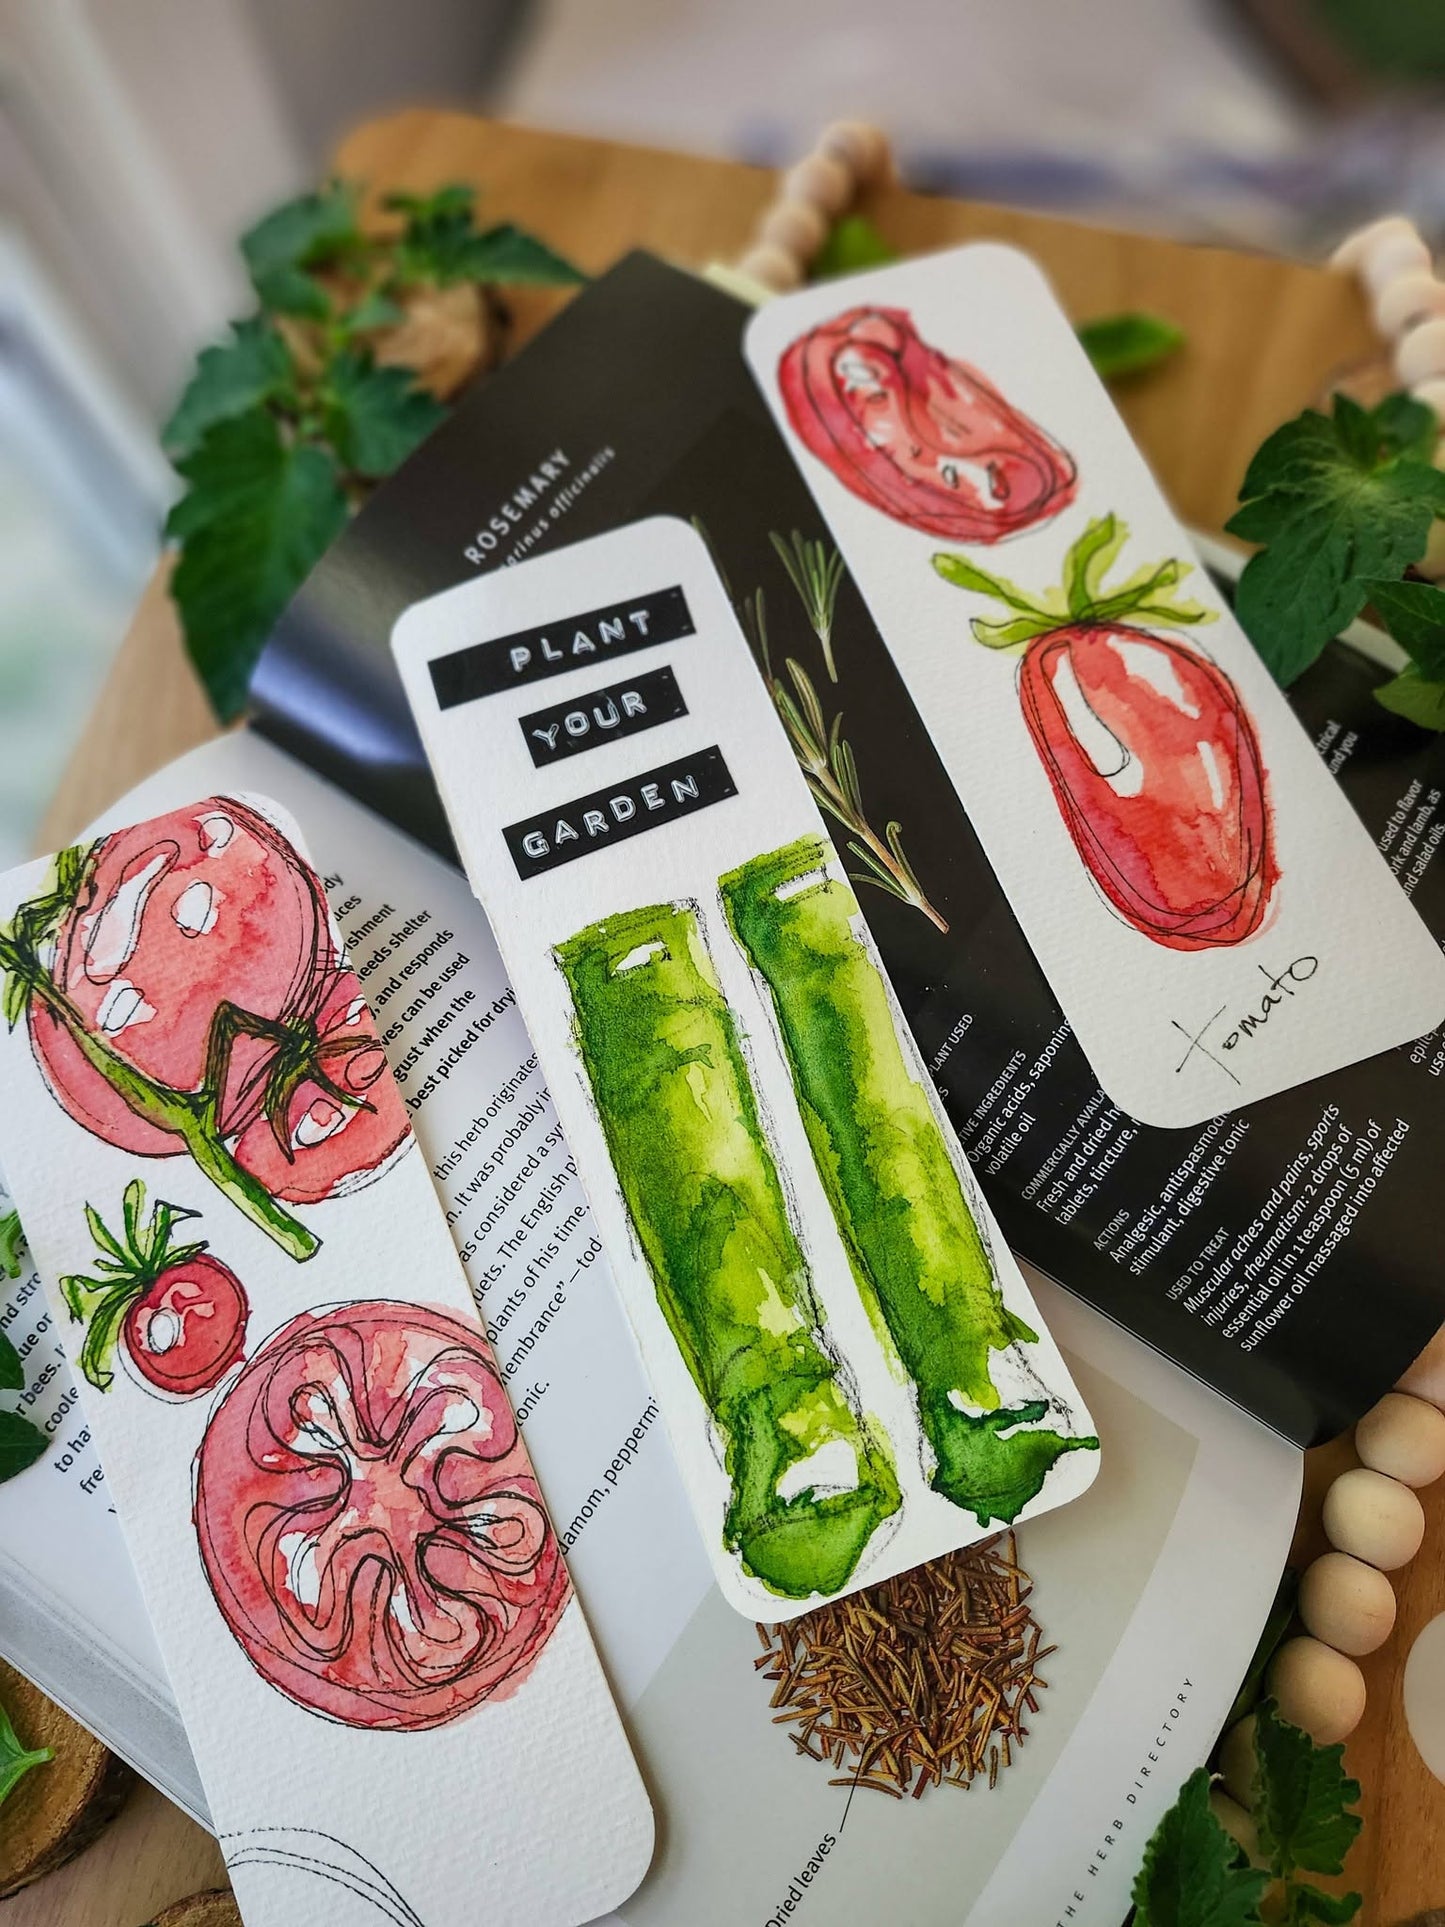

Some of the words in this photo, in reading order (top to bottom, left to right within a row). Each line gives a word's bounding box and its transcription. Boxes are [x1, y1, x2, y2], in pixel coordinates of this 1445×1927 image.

[464, 450, 569, 565] ROSEMARY
[505, 519, 549, 569] arinus
[510, 609, 650, 673] PLANT
[532, 690, 648, 751] YOUR
[1338, 731, 1358, 756] you
[522, 774, 701, 859] GARDEN
[1390, 811, 1407, 824] to
[1396, 779, 1423, 812] flavor
[1407, 806, 1436, 834] lamb,
[1427, 789, 1441, 804] as
[1376, 821, 1400, 852] used
[1390, 854, 1407, 876] ork
[1399, 831, 1418, 856] and
[1412, 841, 1436, 876] salad
[389, 910, 432, 949] shelter
[376, 976, 403, 1004] and
[398, 929, 454, 981] responds
[381, 1021, 404, 1046] ves
[401, 998, 427, 1022] can
[419, 981, 443, 999] be
[438, 952, 471, 983] used
[948, 1014, 973, 1044] USED
[392, 1046, 425, 1084] gust
[419, 1011, 457, 1047] when
[449, 990, 476, 1012] the
[404, 1075, 441, 1110] best
[436, 1029, 480, 1080] picked
[472, 1011, 496, 1033] for
[491, 987, 517, 1014] dryi
[958, 1117, 979, 1145] TIVE
[973, 1050, 1026, 1120] INGREDIENTS
[967, 1116, 1007, 1162] Organic
[1001, 1082, 1036, 1118] acids,
[1367, 1118, 1382, 1139] of
[432, 1151, 462, 1181] this
[454, 1117, 489, 1152] herb
[454, 1192, 473, 1207] It
[466, 1162, 495, 1193] was
[490, 1099, 545, 1166] probably
[985, 1132, 1023, 1175] volatile
[1018, 1112, 1036, 1133] oil
[1021, 1124, 1081, 1200] COMMERCIALLY
[1076, 1089, 1105, 1128] AVAILA
[1310, 1143, 1343, 1184] drops
[1338, 1123, 1353, 1143] of
[1352, 1138, 1374, 1164] ml)
[1036, 1180, 1069, 1213] Fresh
[1064, 1152, 1088, 1182] and
[1081, 1117, 1113, 1156] dried
[1054, 1183, 1099, 1225] tablets,
[1089, 1129, 1138, 1181] tincture,
[1109, 1204, 1167, 1264] Analgesic,
[1159, 1115, 1227, 1203] antispasmod
[1304, 1184, 1318, 1196] 2
[1339, 1163, 1360, 1180] (5
[457, 1241, 477, 1264] as
[474, 1154, 541, 1241] considered
[536, 1146, 550, 1157] a
[496, 1230, 528, 1259] The
[520, 1173, 570, 1230] English
[1129, 1218, 1185, 1275] stimulant,
[1177, 1155, 1226, 1216] digestive
[1218, 1119, 1250, 1155] tonic
[1183, 1256, 1234, 1314] Muscular
[1231, 1219, 1264, 1261] aches
[1260, 1188, 1284, 1221] and
[1279, 1152, 1314, 1197] pains,
[1307, 1103, 1339, 1151] sports
[1296, 1179, 1348, 1245] teaspoon
[1093, 1208, 1130, 1251] ACTIONS
[1240, 1292, 1295, 1352] sunflower
[1291, 1273, 1310, 1294] oil
[1304, 1203, 1359, 1277] massaged
[1349, 1177, 1376, 1206] into
[1371, 1118, 1410, 1178] affected
[1244, 1195, 1310, 1281] rheumatism:
[1293, 1244, 1305, 1254] 1
[483, 1289, 526, 1346] plants
[523, 1264, 540, 1288] of
[532, 1242, 559, 1269] his
[553, 1205, 590, 1242] time.
[1165, 1275, 1192, 1300] USED
[1187, 1260, 1204, 1276] TO
[1198, 1226, 1229, 1261] TREAT
[1268, 1265, 1287, 1287] oil
[1277, 1253, 1298, 1269] in
[1200, 1281, 1250, 1327] injuries,
[1222, 1283, 1273, 1338] essential
[19, 1363, 61, 1406] bees.
[54, 1454, 74, 1473] to
[1087, 1819, 1123, 1876] HERB
[1126, 1678, 1193, 1805] DIRECTORY
[765, 1885, 803, 1927] Dried
[793, 1831, 837, 1889] leaves
